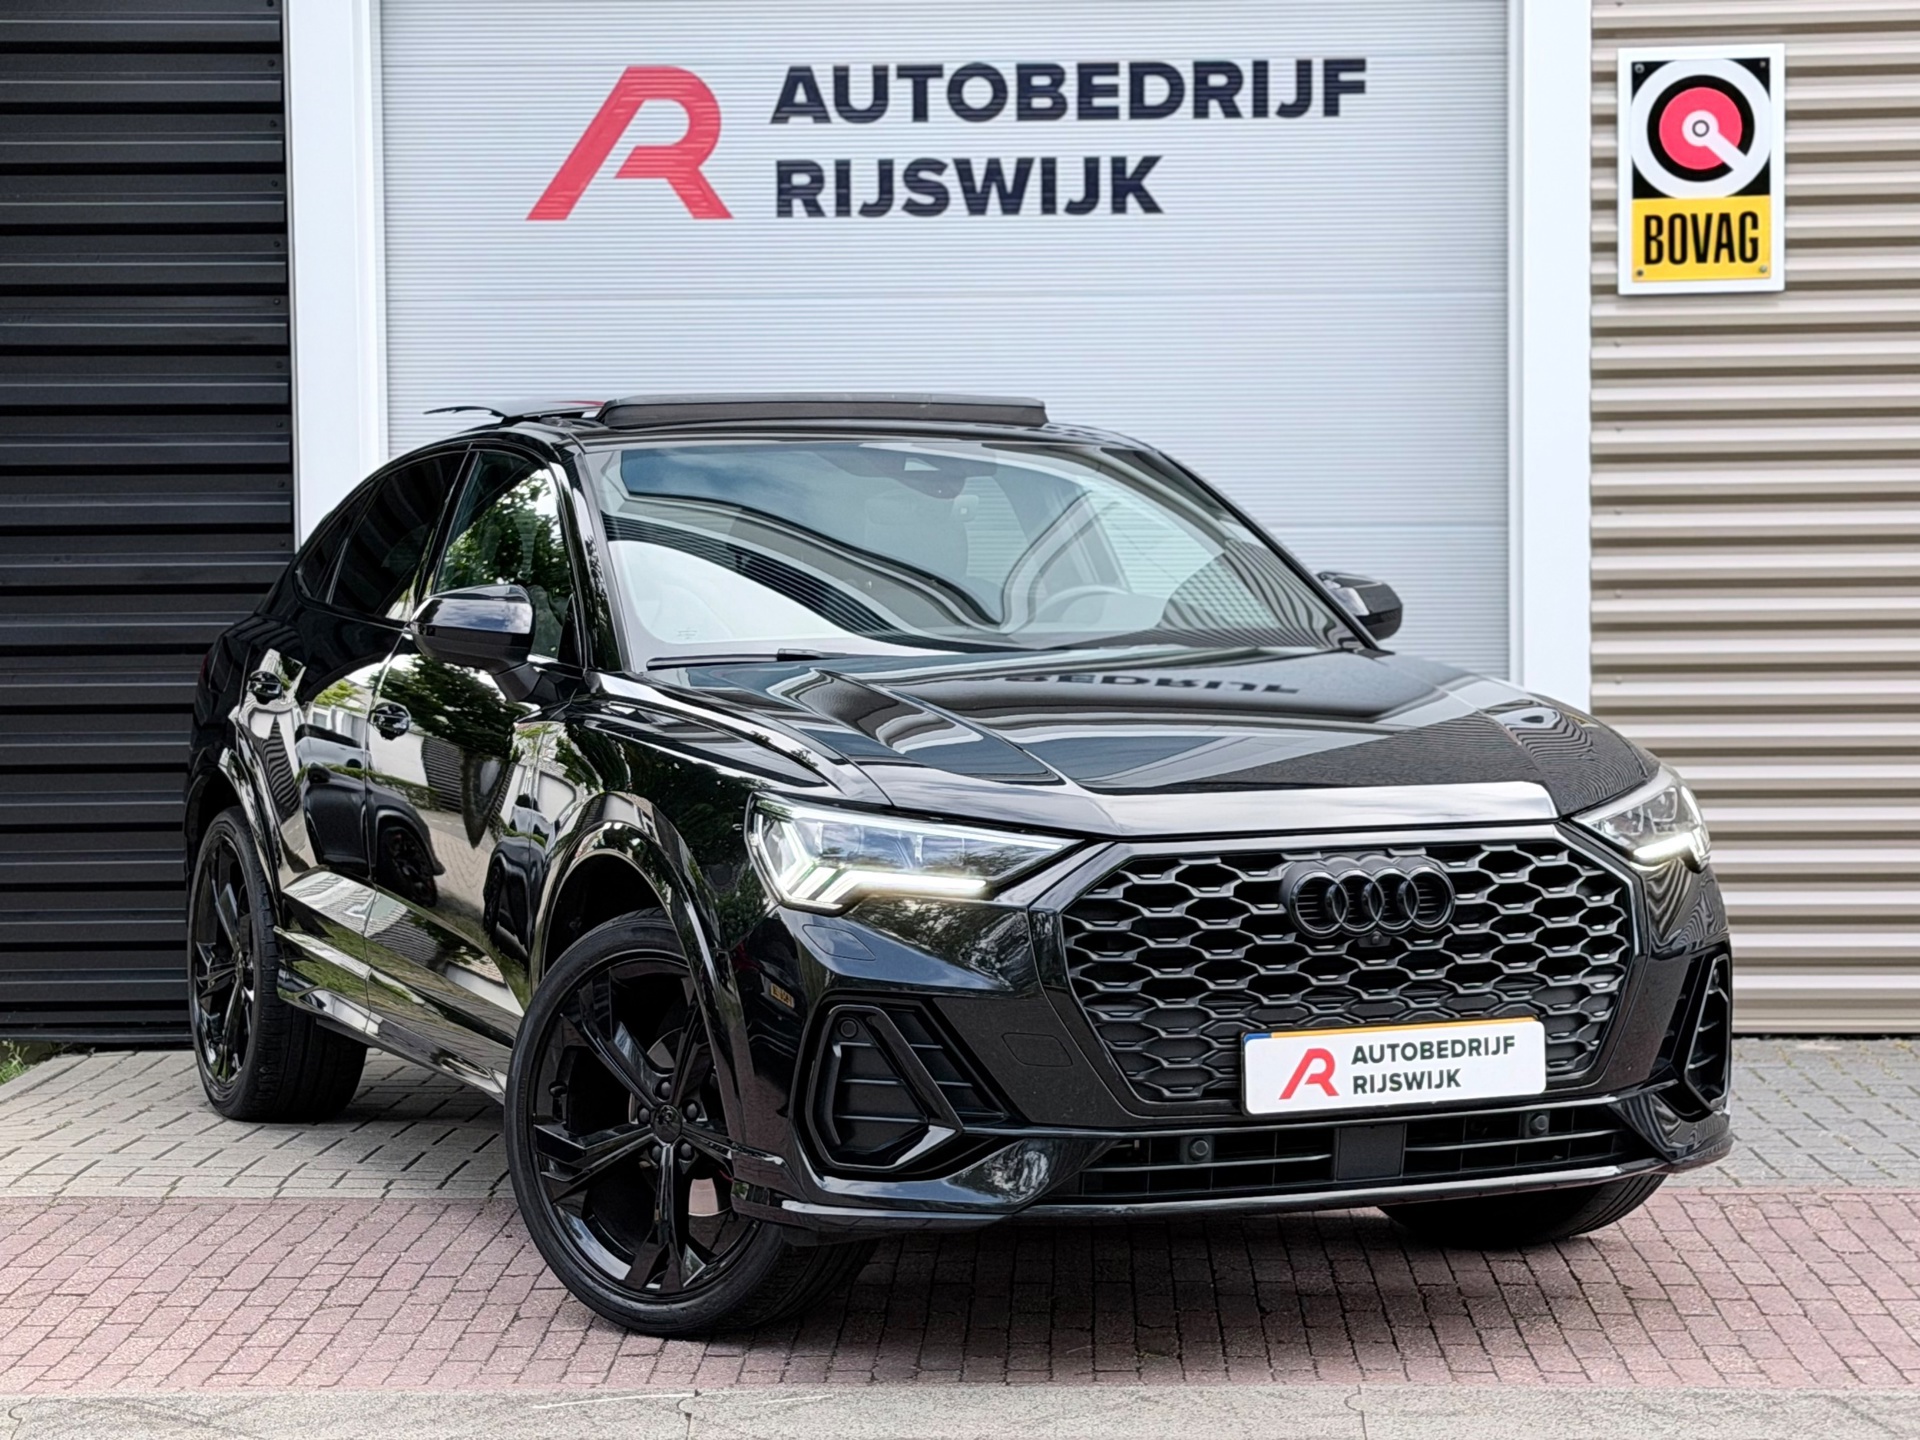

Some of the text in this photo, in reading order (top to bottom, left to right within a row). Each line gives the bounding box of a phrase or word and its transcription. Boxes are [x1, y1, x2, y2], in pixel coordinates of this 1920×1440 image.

[770, 58, 1367, 124] AUTOBEDRIJF
[776, 155, 1164, 218] RIJSWIJK
[1644, 211, 1759, 265] BOVAG
[1351, 1035, 1516, 1066] AUTOBEDRIJF
[1353, 1069, 1462, 1095] RIJSWIJK
